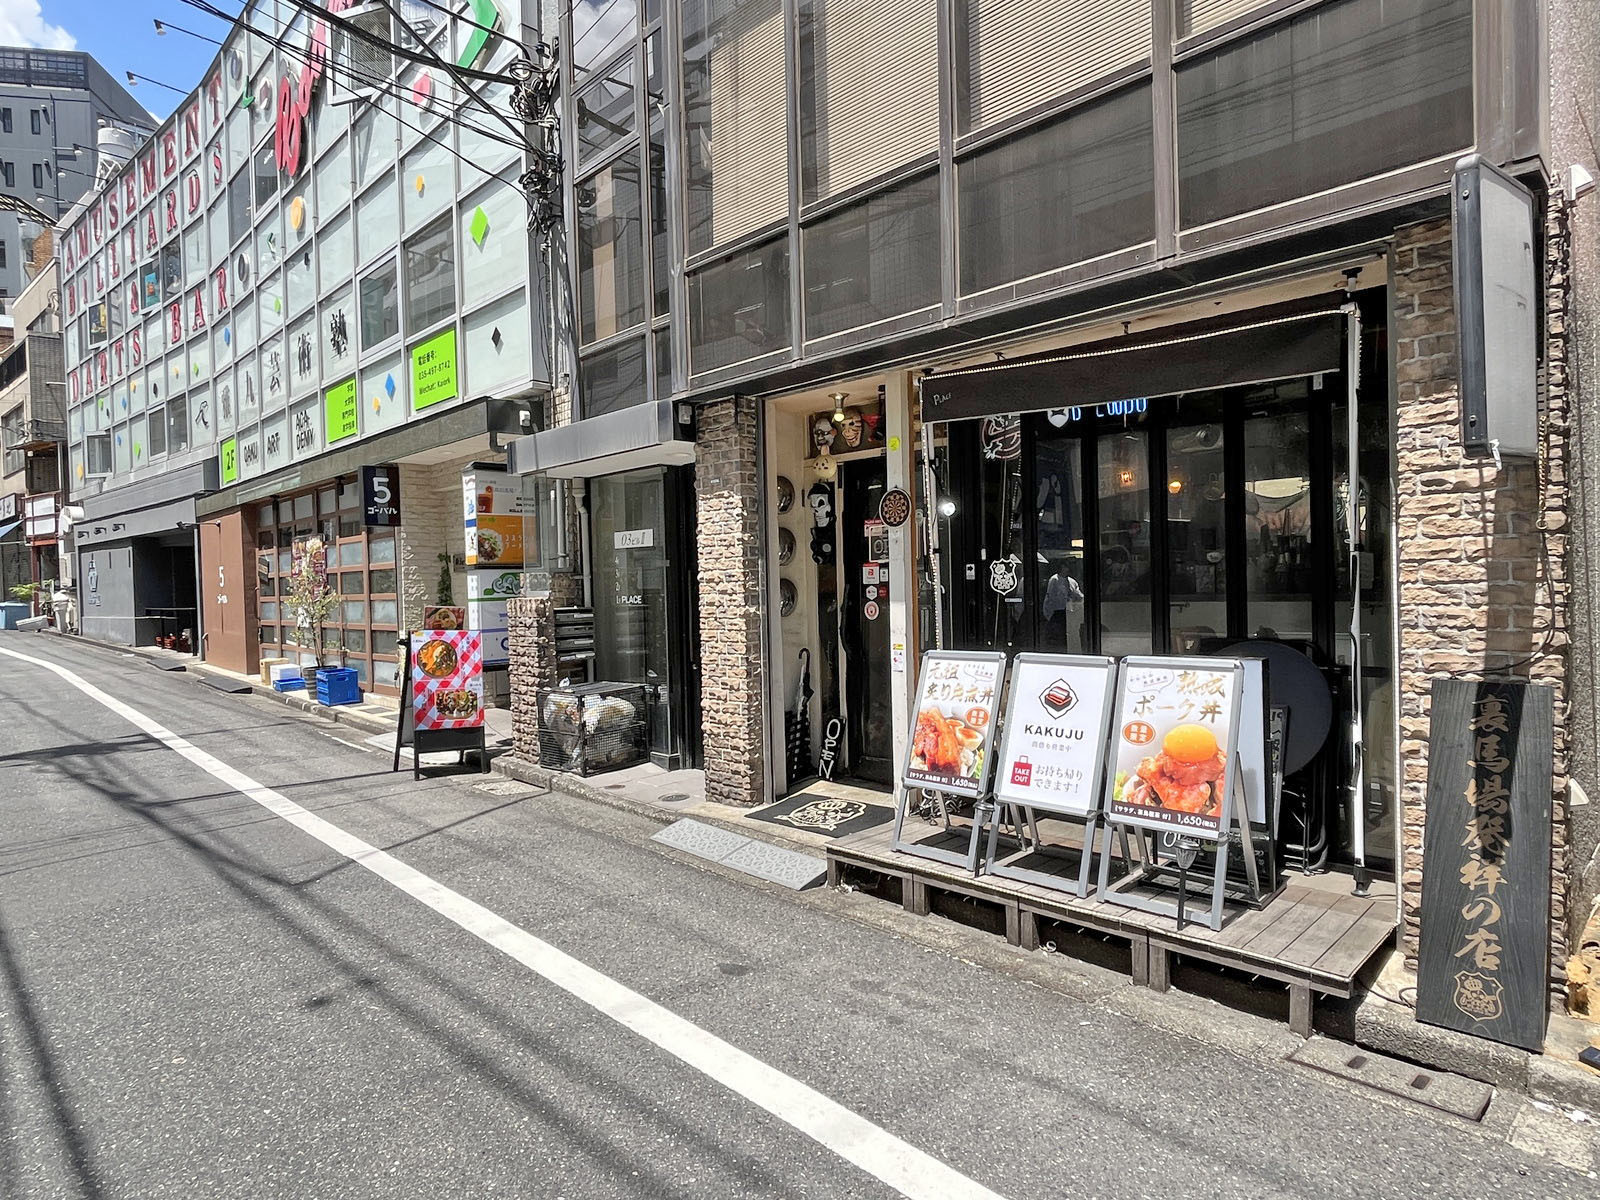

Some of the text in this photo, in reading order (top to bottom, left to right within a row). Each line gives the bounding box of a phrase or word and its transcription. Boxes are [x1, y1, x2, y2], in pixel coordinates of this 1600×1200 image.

[65, 71, 223, 274] AMUSEMENT
[67, 141, 223, 316] BILLIARDS
[70, 267, 228, 403] DARTS BAR
[226, 449, 235, 471] 2F
[373, 477, 391, 504] 5
[367, 505, 398, 514] ゴーバル
[218, 566, 225, 587] 5
[621, 595, 642, 604] PLACE
[1133, 695, 1223, 724] ポーク丼
[1024, 724, 1084, 740] KAKUJU
[818, 718, 841, 780] OPEN
[1014, 767, 1030, 776] TAKE
[1014, 775, 1029, 783] OUT
[1035, 764, 1083, 781] お持ち帰り
[1455, 696, 1512, 972] 裏馬場発祥の店
